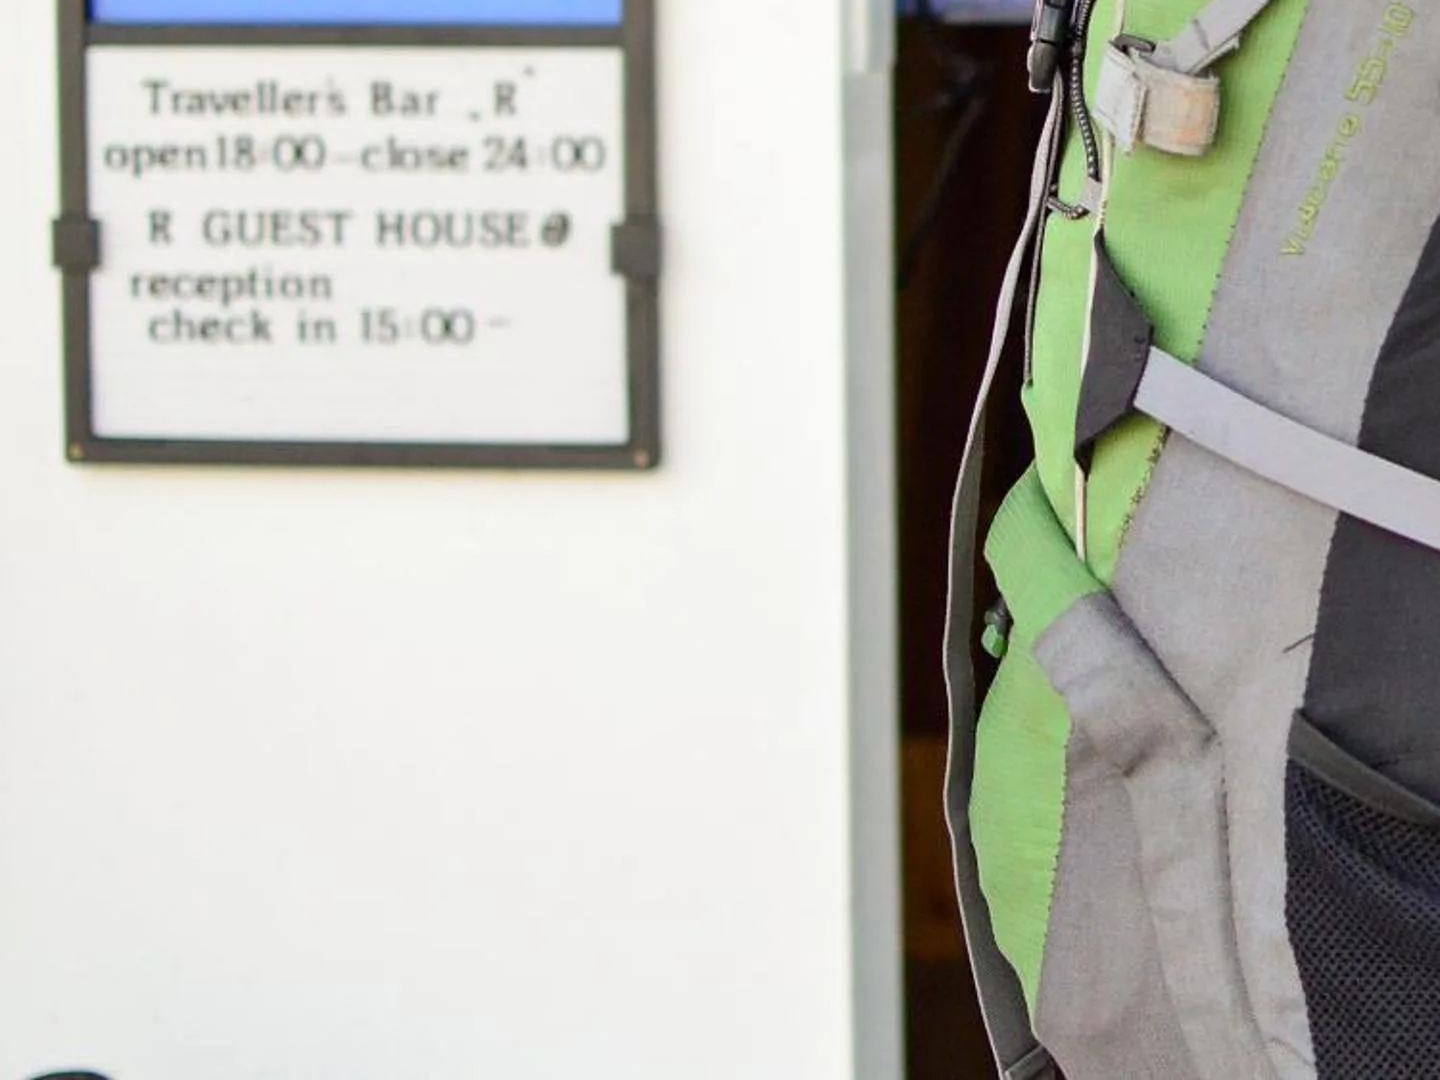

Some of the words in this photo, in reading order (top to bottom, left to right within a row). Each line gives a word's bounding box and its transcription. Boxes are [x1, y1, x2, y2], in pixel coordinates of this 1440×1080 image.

[369, 80, 440, 117] Bar
[147, 209, 174, 247] R
[201, 209, 354, 248] GUEST
[129, 266, 334, 307] reception
[147, 307, 274, 345] check
[297, 307, 338, 345] in
